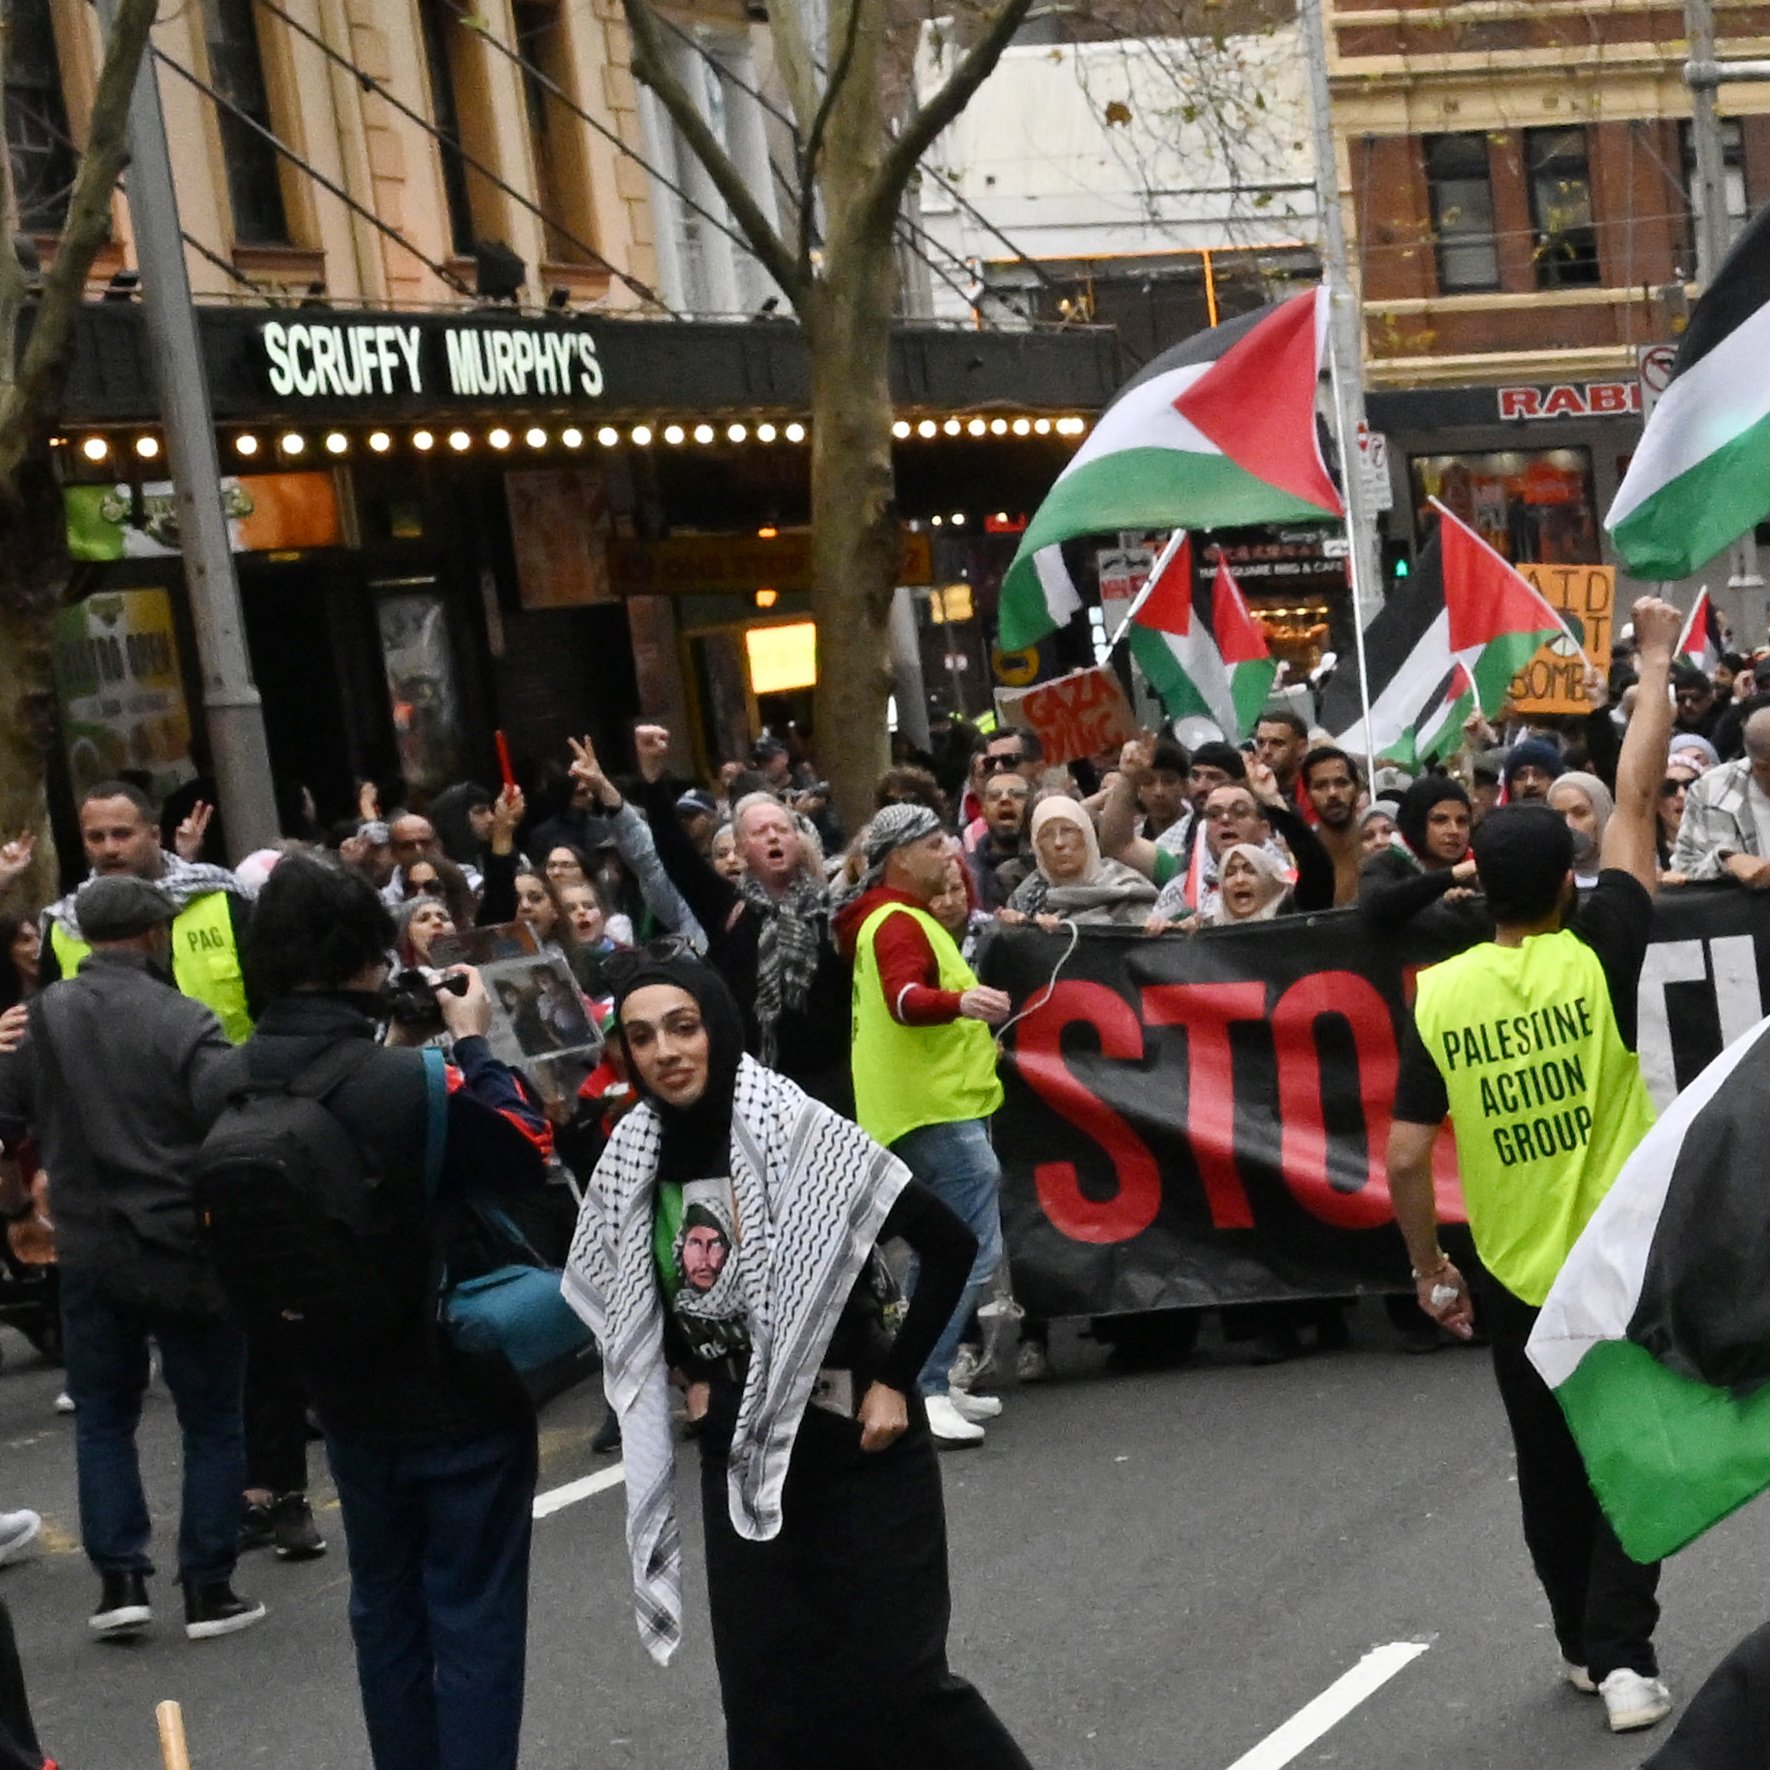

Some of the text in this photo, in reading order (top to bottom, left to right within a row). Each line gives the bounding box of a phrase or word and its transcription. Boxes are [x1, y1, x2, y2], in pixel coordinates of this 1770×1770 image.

[264, 322, 604, 397] SCRUFFY MURPHY'S
[186, 926, 225, 952] PAG
[1442, 997, 1594, 1071] PALESTINE
[1014, 963, 1470, 1245] STO
[1479, 1053, 1587, 1119] ACTION
[1492, 1105, 1593, 1168] GROUP
